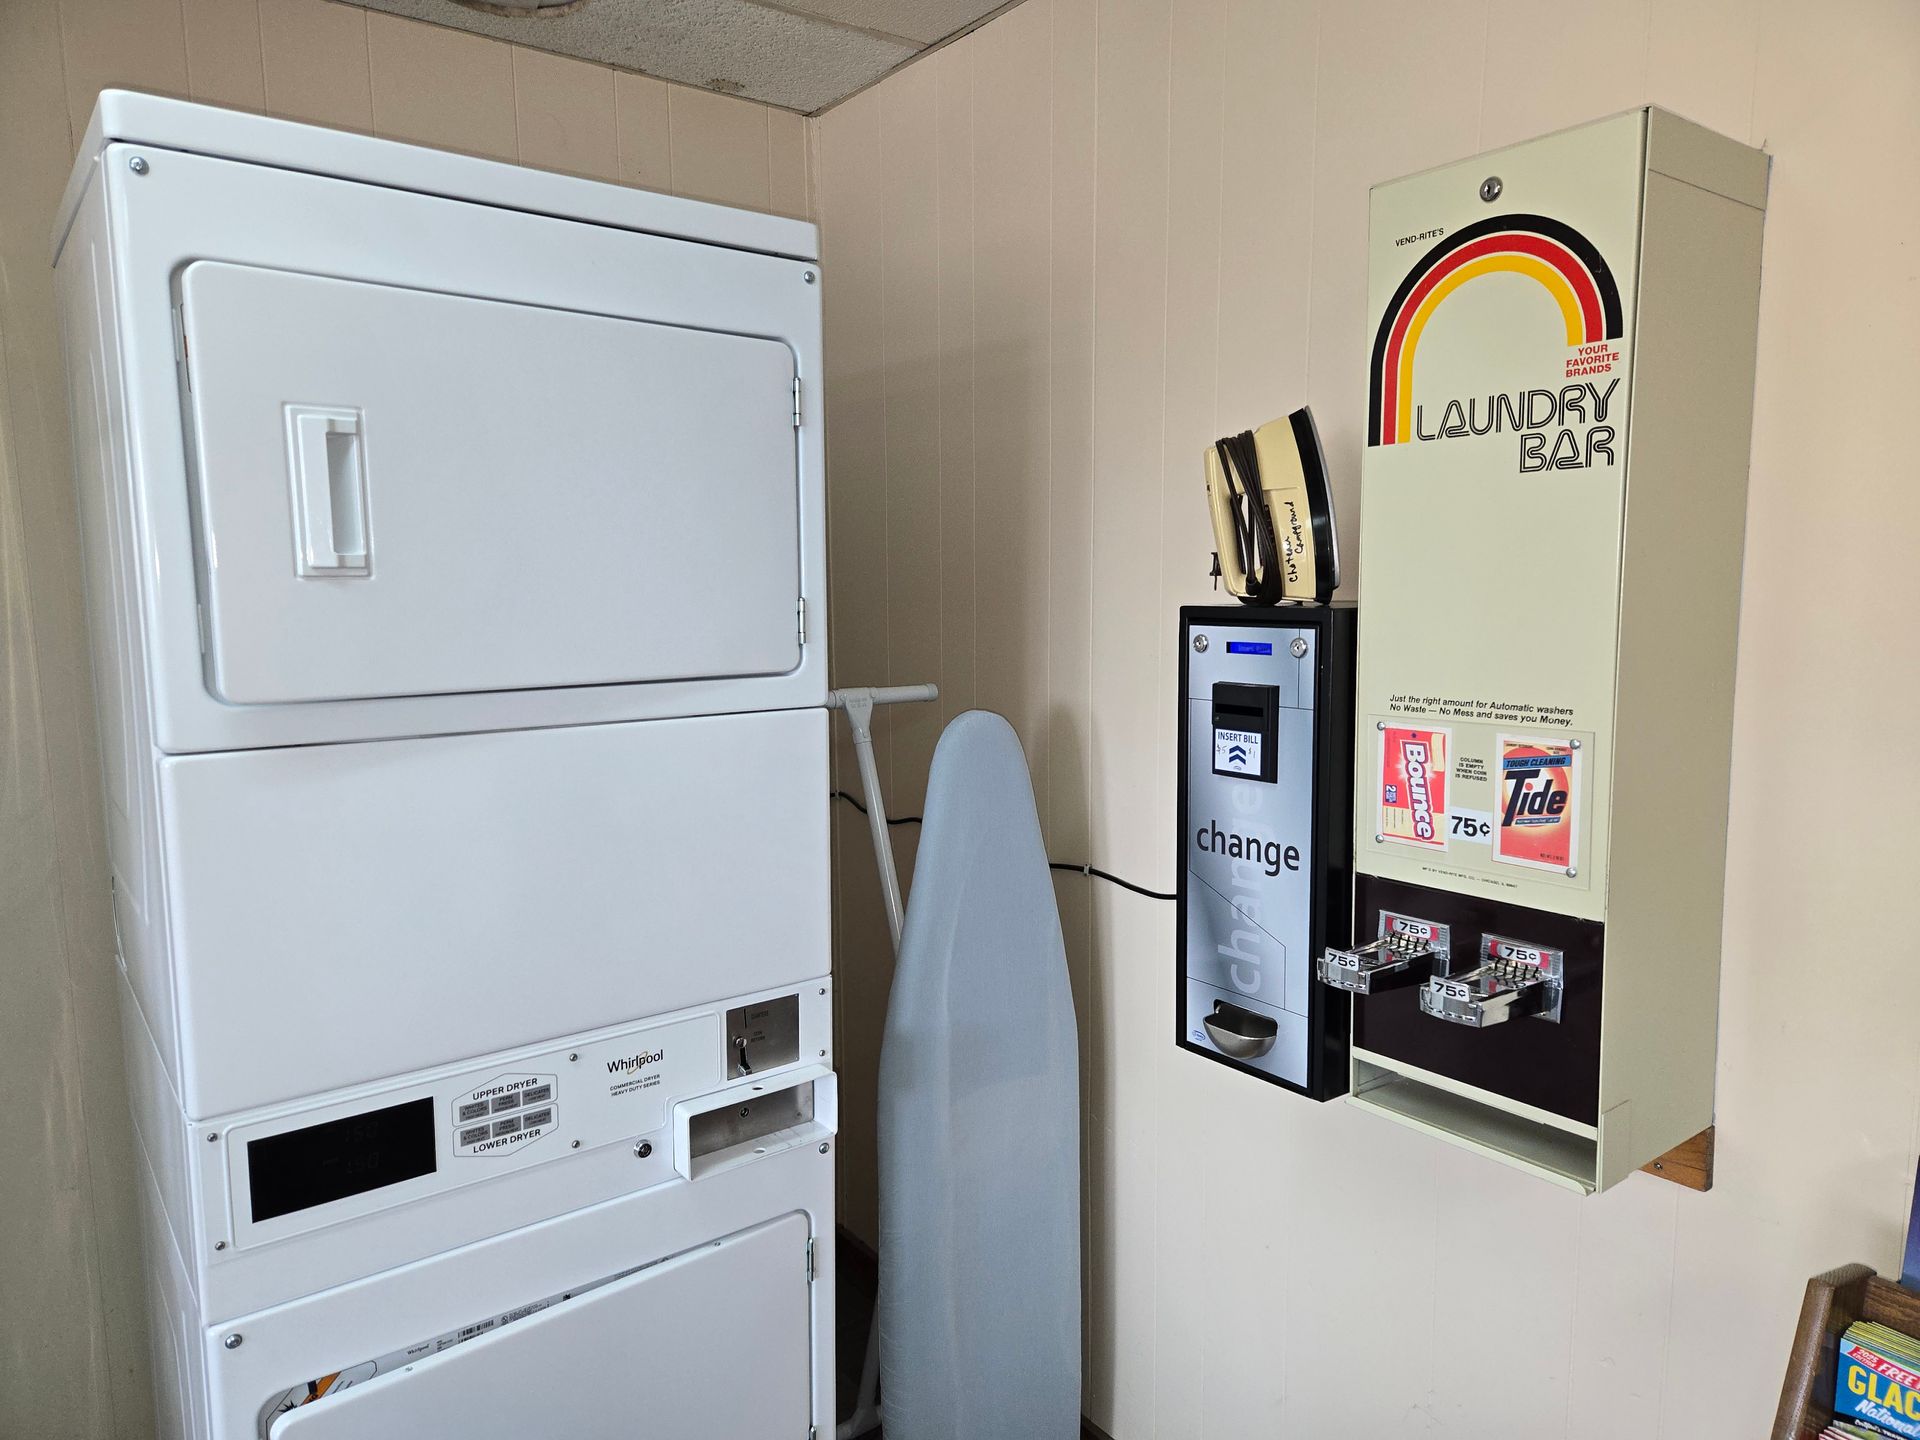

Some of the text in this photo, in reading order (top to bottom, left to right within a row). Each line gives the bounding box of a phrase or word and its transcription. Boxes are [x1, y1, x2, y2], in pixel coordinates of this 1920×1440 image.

[1395, 228, 1444, 247] VEND-RITE'S
[1578, 344, 1609, 357] YOUR
[1566, 352, 1620, 368] FAVORITE
[1565, 363, 1612, 378] BRANDS
[1416, 378, 1621, 441] LAUNDRY
[1519, 425, 1616, 473] BAR
[1389, 694, 1573, 715] Just the right amount for Automatic washers
[1389, 703, 1401, 711] No
[1403, 704, 1426, 713] Waste
[1439, 707, 1451, 715] No
[1453, 708, 1474, 718] Mess
[1476, 711, 1492, 719] and
[1494, 712, 1518, 721] saves
[1520, 715, 1537, 723] you
[1539, 715, 1573, 727] Money.
[1217, 731, 1258, 744] INSERT BILL
[1506, 757, 1566, 767] TOUGH CLEANING
[1461, 774, 1488, 782] REFUSED
[1386, 784, 1397, 793] 2
[1403, 742, 1434, 839] Bounce
[1501, 769, 1568, 827] Tide
[1451, 815, 1491, 837] 75¢
[1196, 819, 1300, 877] change
[1399, 921, 1427, 935] 75¢
[1328, 952, 1356, 967] 75¢
[1504, 946, 1537, 960] 75¢
[1434, 981, 1466, 997] 75¢
[606, 1049, 663, 1073] Whirlpool
[472, 1077, 538, 1100] UPPER DRYER
[609, 1074, 660, 1091] COMMERCIAL DRYER
[611, 1080, 660, 1097] HEAVY DUTY SERIES
[473, 1138, 508, 1154] LOWER
[510, 1129, 541, 1144] DRYER
[1852, 1352, 1877, 1368] EDITION
[1856, 1349, 1880, 1363] 2025
[1877, 1363, 1918, 1386] FREE
[1847, 1365, 1920, 1421] GLAC
